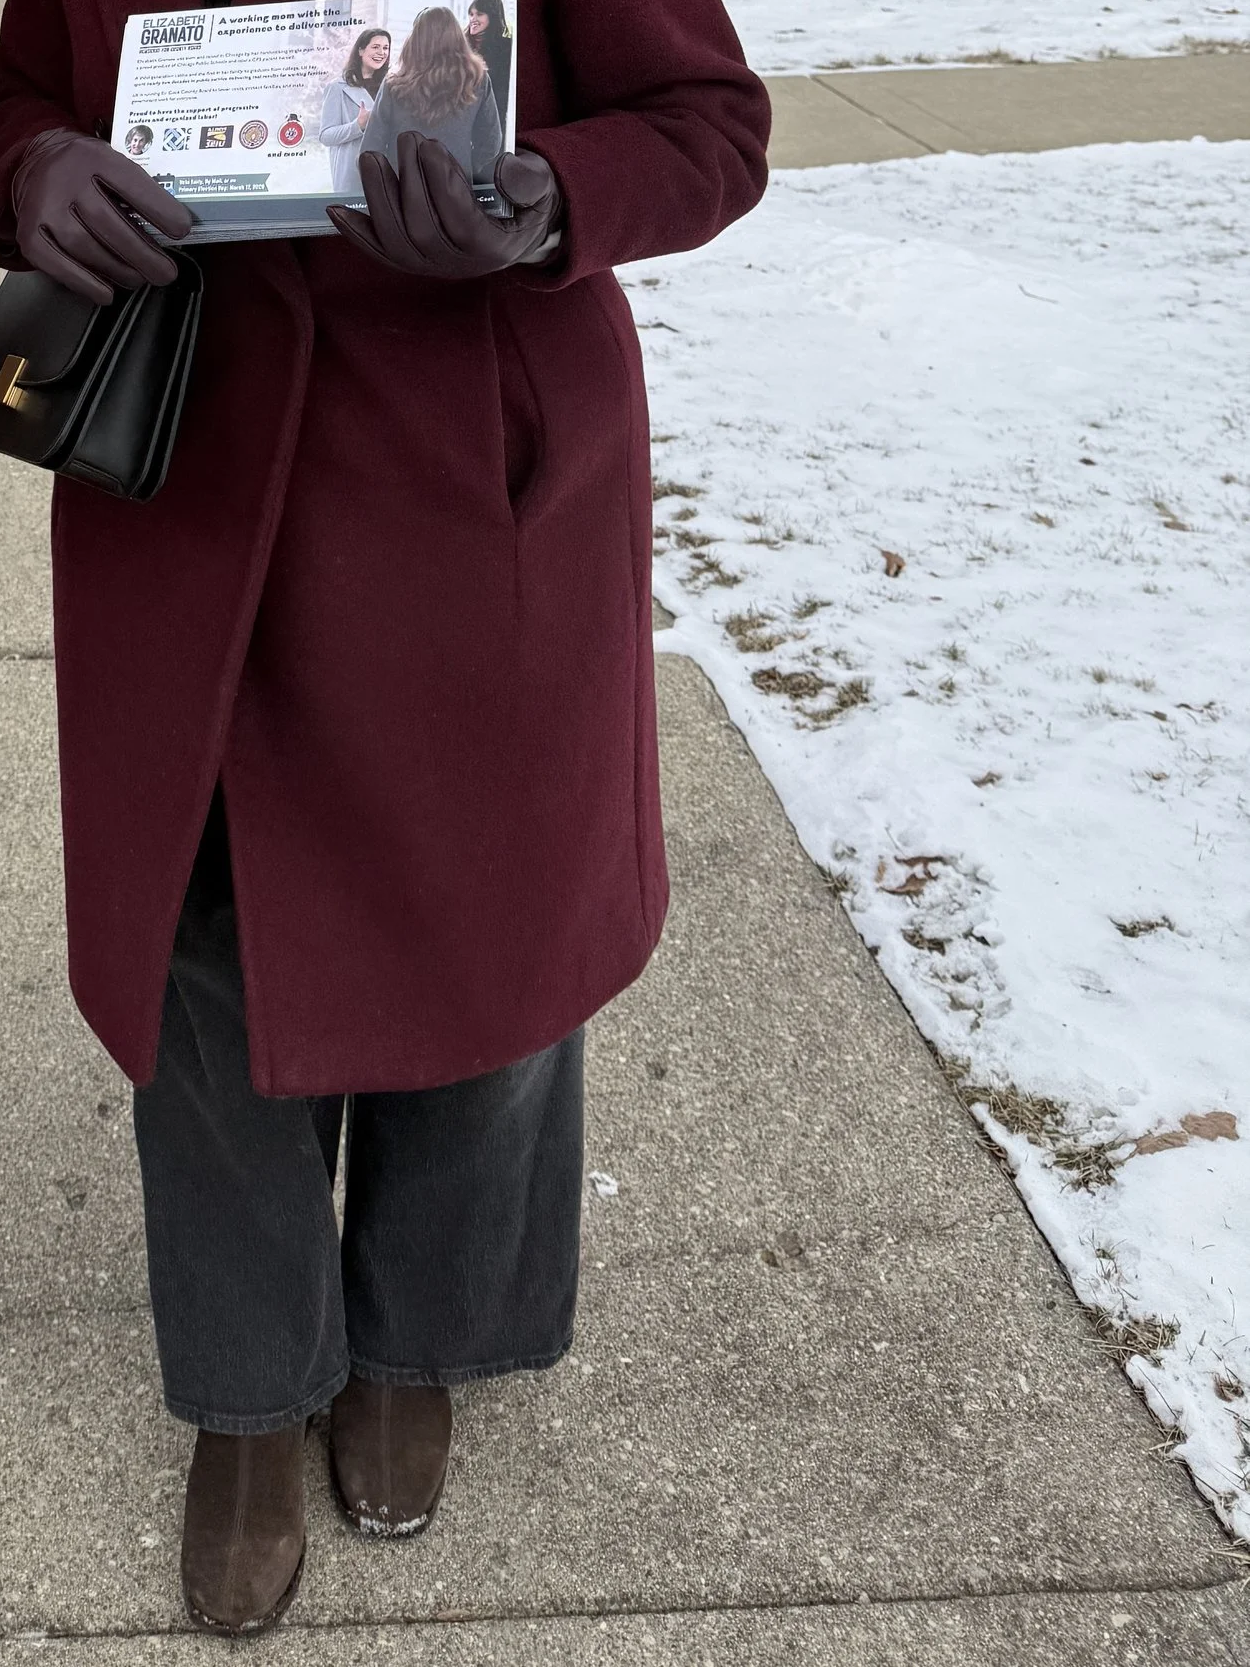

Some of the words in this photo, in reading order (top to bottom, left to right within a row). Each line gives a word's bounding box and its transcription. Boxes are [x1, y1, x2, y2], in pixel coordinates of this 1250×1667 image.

[143, 14, 206, 29] ELIZABETH
[218, 17, 227, 25] A
[229, 14, 269, 24] working
[271, 13, 295, 21] mom
[297, 9, 321, 18] with
[323, 8, 341, 16] the
[217, 25, 273, 36] experience
[288, 21, 324, 30] deliver
[327, 17, 366, 28] results.
[140, 25, 204, 45] GRANATO
[186, 107, 211, 115] support
[221, 104, 259, 112] progressive
[165, 114, 197, 124] organized
